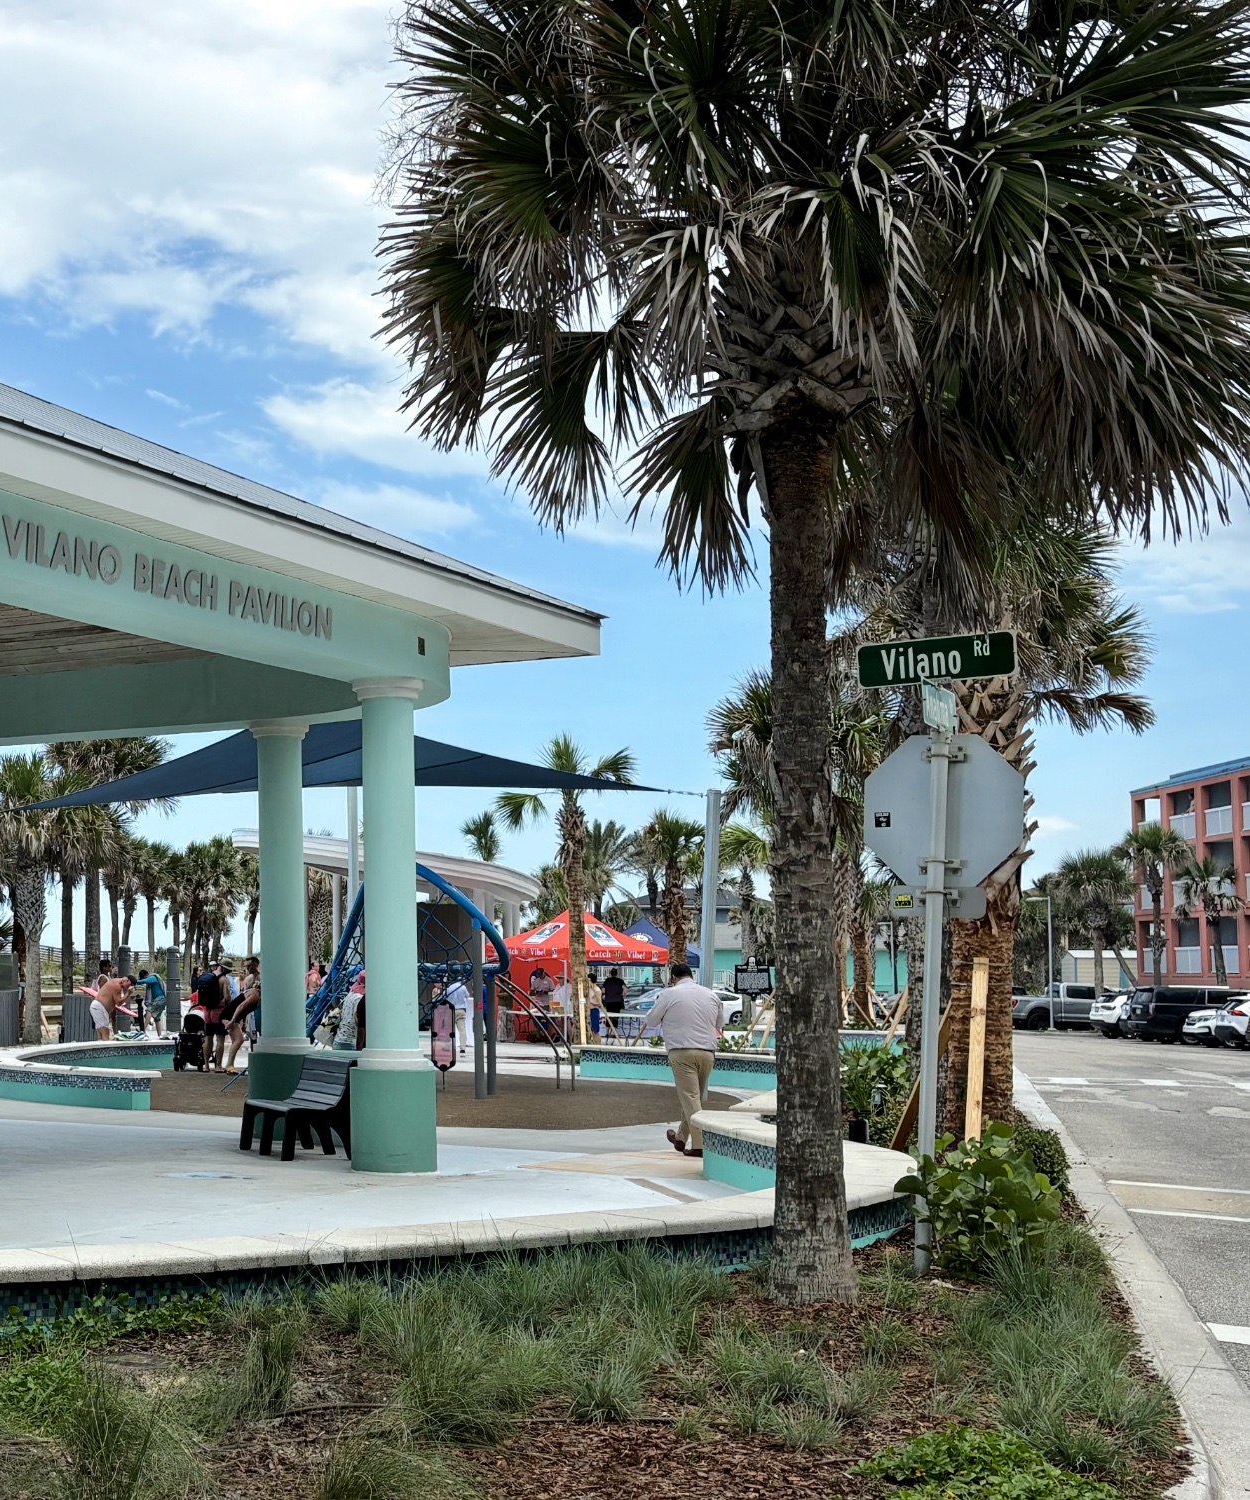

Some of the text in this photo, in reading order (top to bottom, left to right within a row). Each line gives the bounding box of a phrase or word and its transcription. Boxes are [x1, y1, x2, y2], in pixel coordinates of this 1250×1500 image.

[2, 515, 332, 641] VILANO BEACH PAVILION
[880, 639, 990, 681] Vilano Rd
[588, 949, 612, 959] Catch
[626, 950, 646, 960] Vibe!
